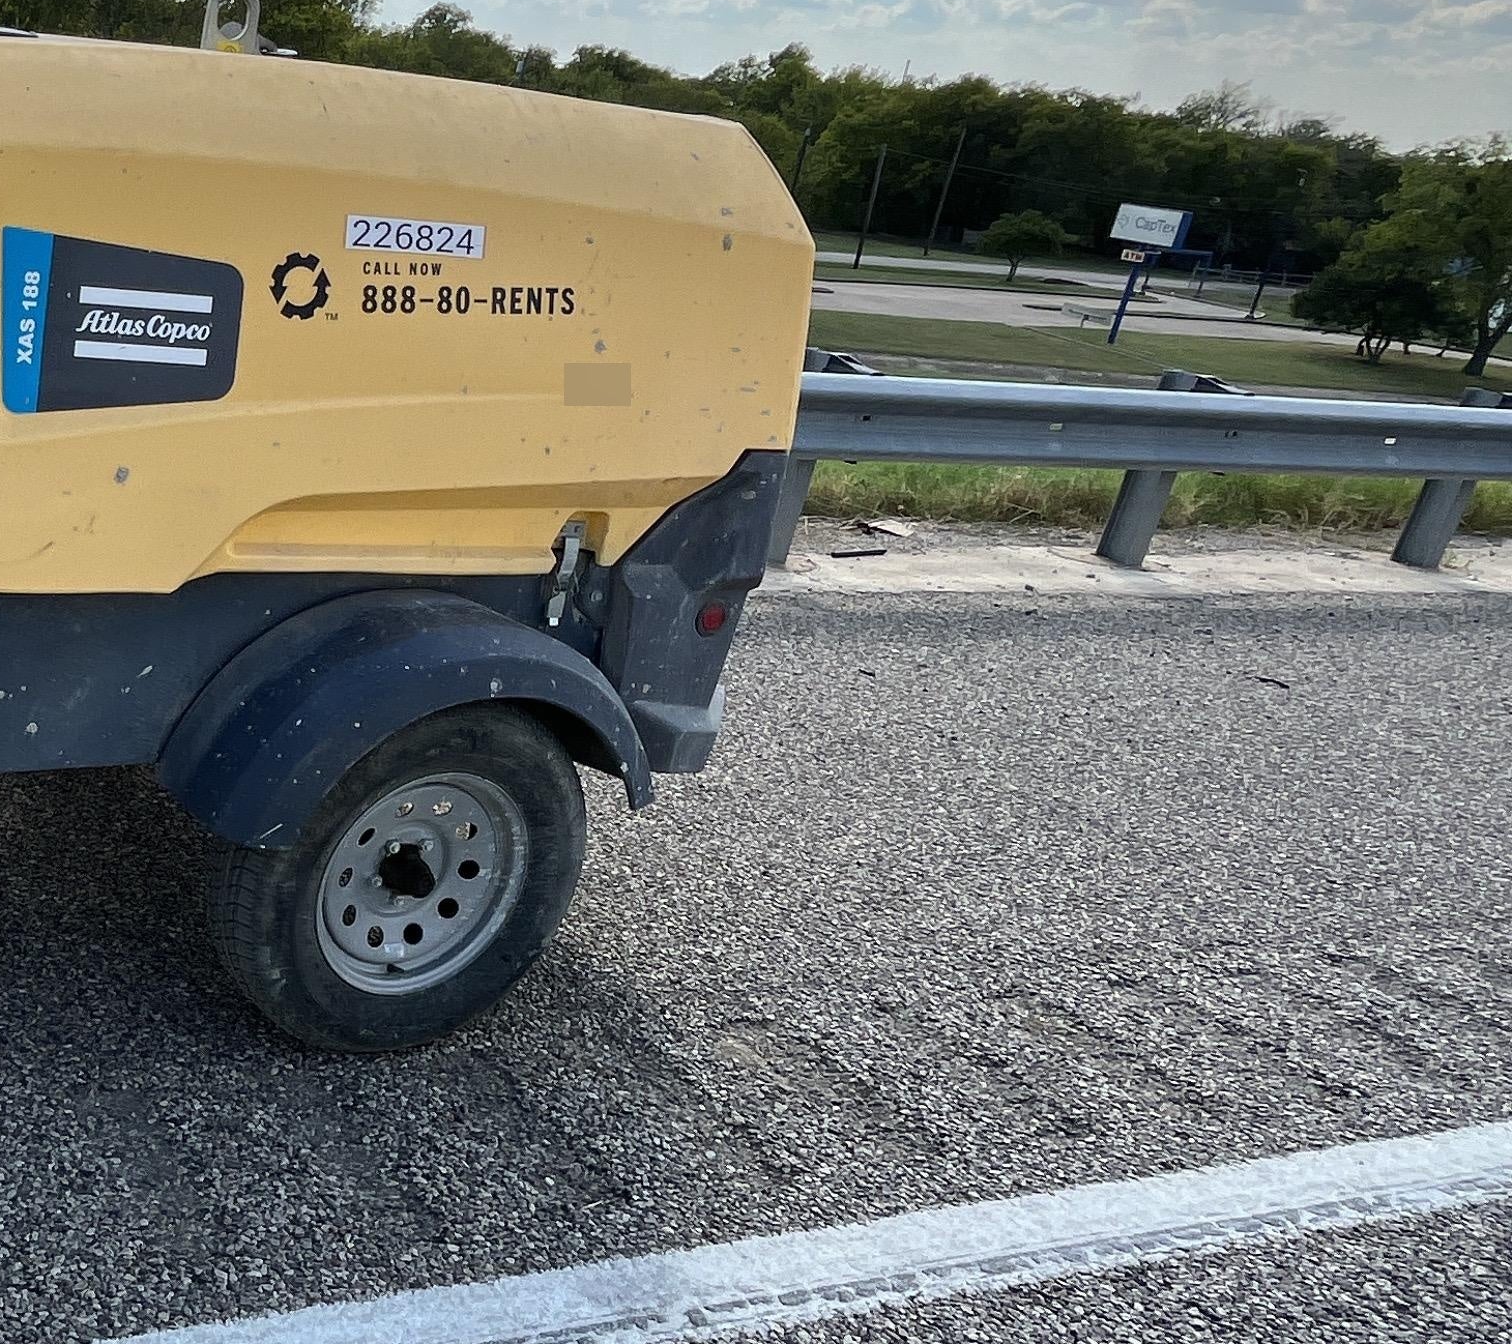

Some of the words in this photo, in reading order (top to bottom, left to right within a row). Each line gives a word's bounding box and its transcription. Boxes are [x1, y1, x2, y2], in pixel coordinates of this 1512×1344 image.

[352, 219, 475, 255] 226824
[363, 261, 401, 276] CALL
[409, 262, 443, 276] NOW
[22, 271, 40, 311] 188
[361, 284, 575, 316] 888-80-RENTS
[16, 317, 36, 366] XAS
[76, 309, 145, 337] Atlas
[146, 313, 212, 344] Copco
